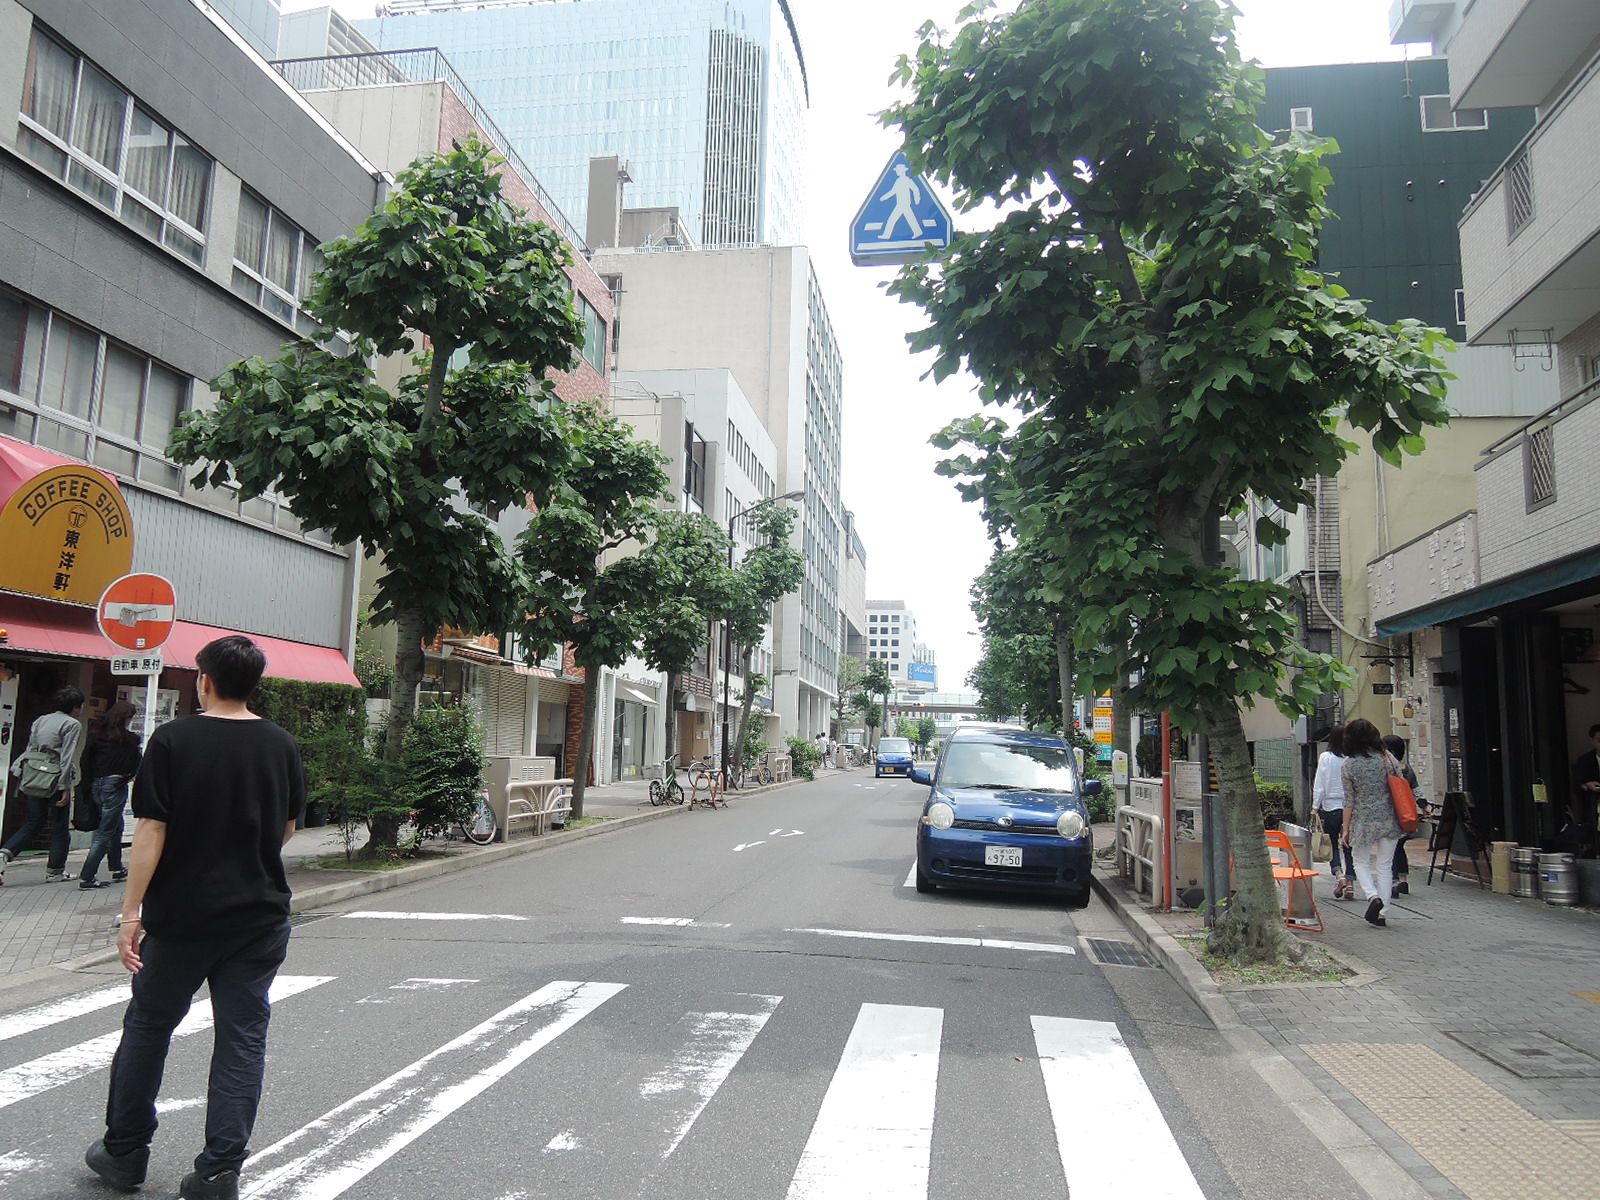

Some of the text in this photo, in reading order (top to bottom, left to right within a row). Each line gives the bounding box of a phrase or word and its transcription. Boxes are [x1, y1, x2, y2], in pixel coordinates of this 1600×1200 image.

[23, 479, 123, 539] COFFEE SHOP
[53, 529, 81, 592] 東洋軒
